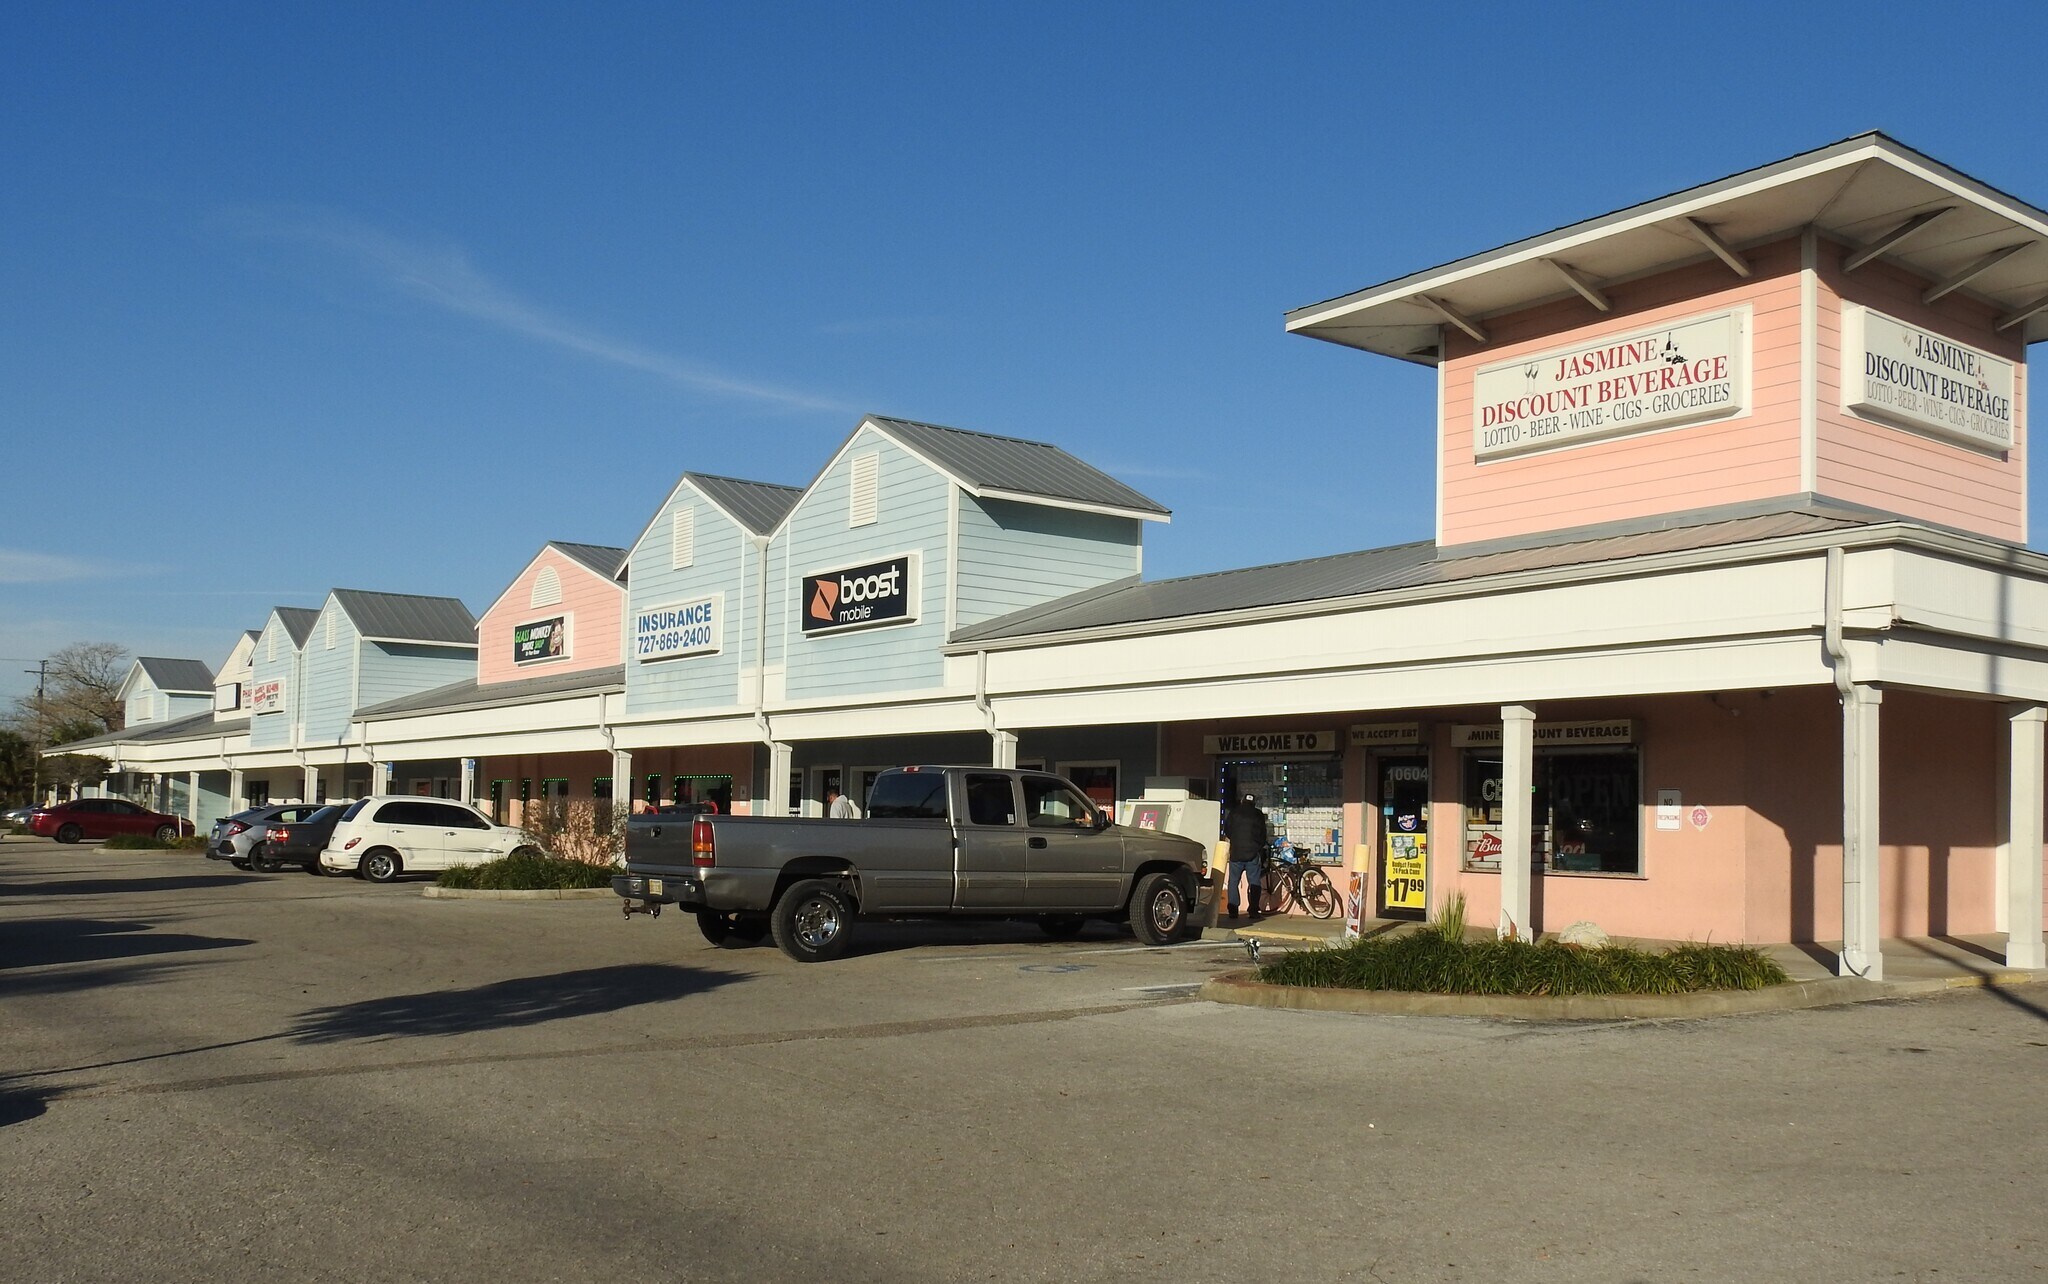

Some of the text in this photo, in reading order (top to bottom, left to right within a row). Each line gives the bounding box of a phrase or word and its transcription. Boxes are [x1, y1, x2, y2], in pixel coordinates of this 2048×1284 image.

[1555, 339, 1658, 381] JASMINE
[1915, 334, 1975, 377] JASMINE
[1482, 355, 1728, 427] DISCOUNT BEVERAGE
[1865, 352, 2009, 421] DISCOUNT BEVERAGE
[1484, 424, 1520, 448] LOTTO
[1530, 416, 1560, 438] BEER
[1569, 408, 1603, 430] WINE
[1613, 400, 1642, 421] CIGS
[1652, 382, 1731, 414] GROCERIES
[1867, 380, 1892, 404] LOTTO
[1898, 389, 1917, 412] BEER
[1923, 397, 1944, 420] WINE
[1949, 406, 1965, 427] CIGS
[1971, 412, 2010, 440] GROCERIES
[840, 565, 900, 604] boost
[638, 603, 712, 633] INSURANCE
[840, 604, 871, 622] mobile
[1218, 734, 1318, 751] WELCOME TO
[1352, 728, 1418, 740] WE ACCEPT EBT
[1566, 726, 1629, 738] BEVERAGE
[1388, 767, 1429, 780] 10604
